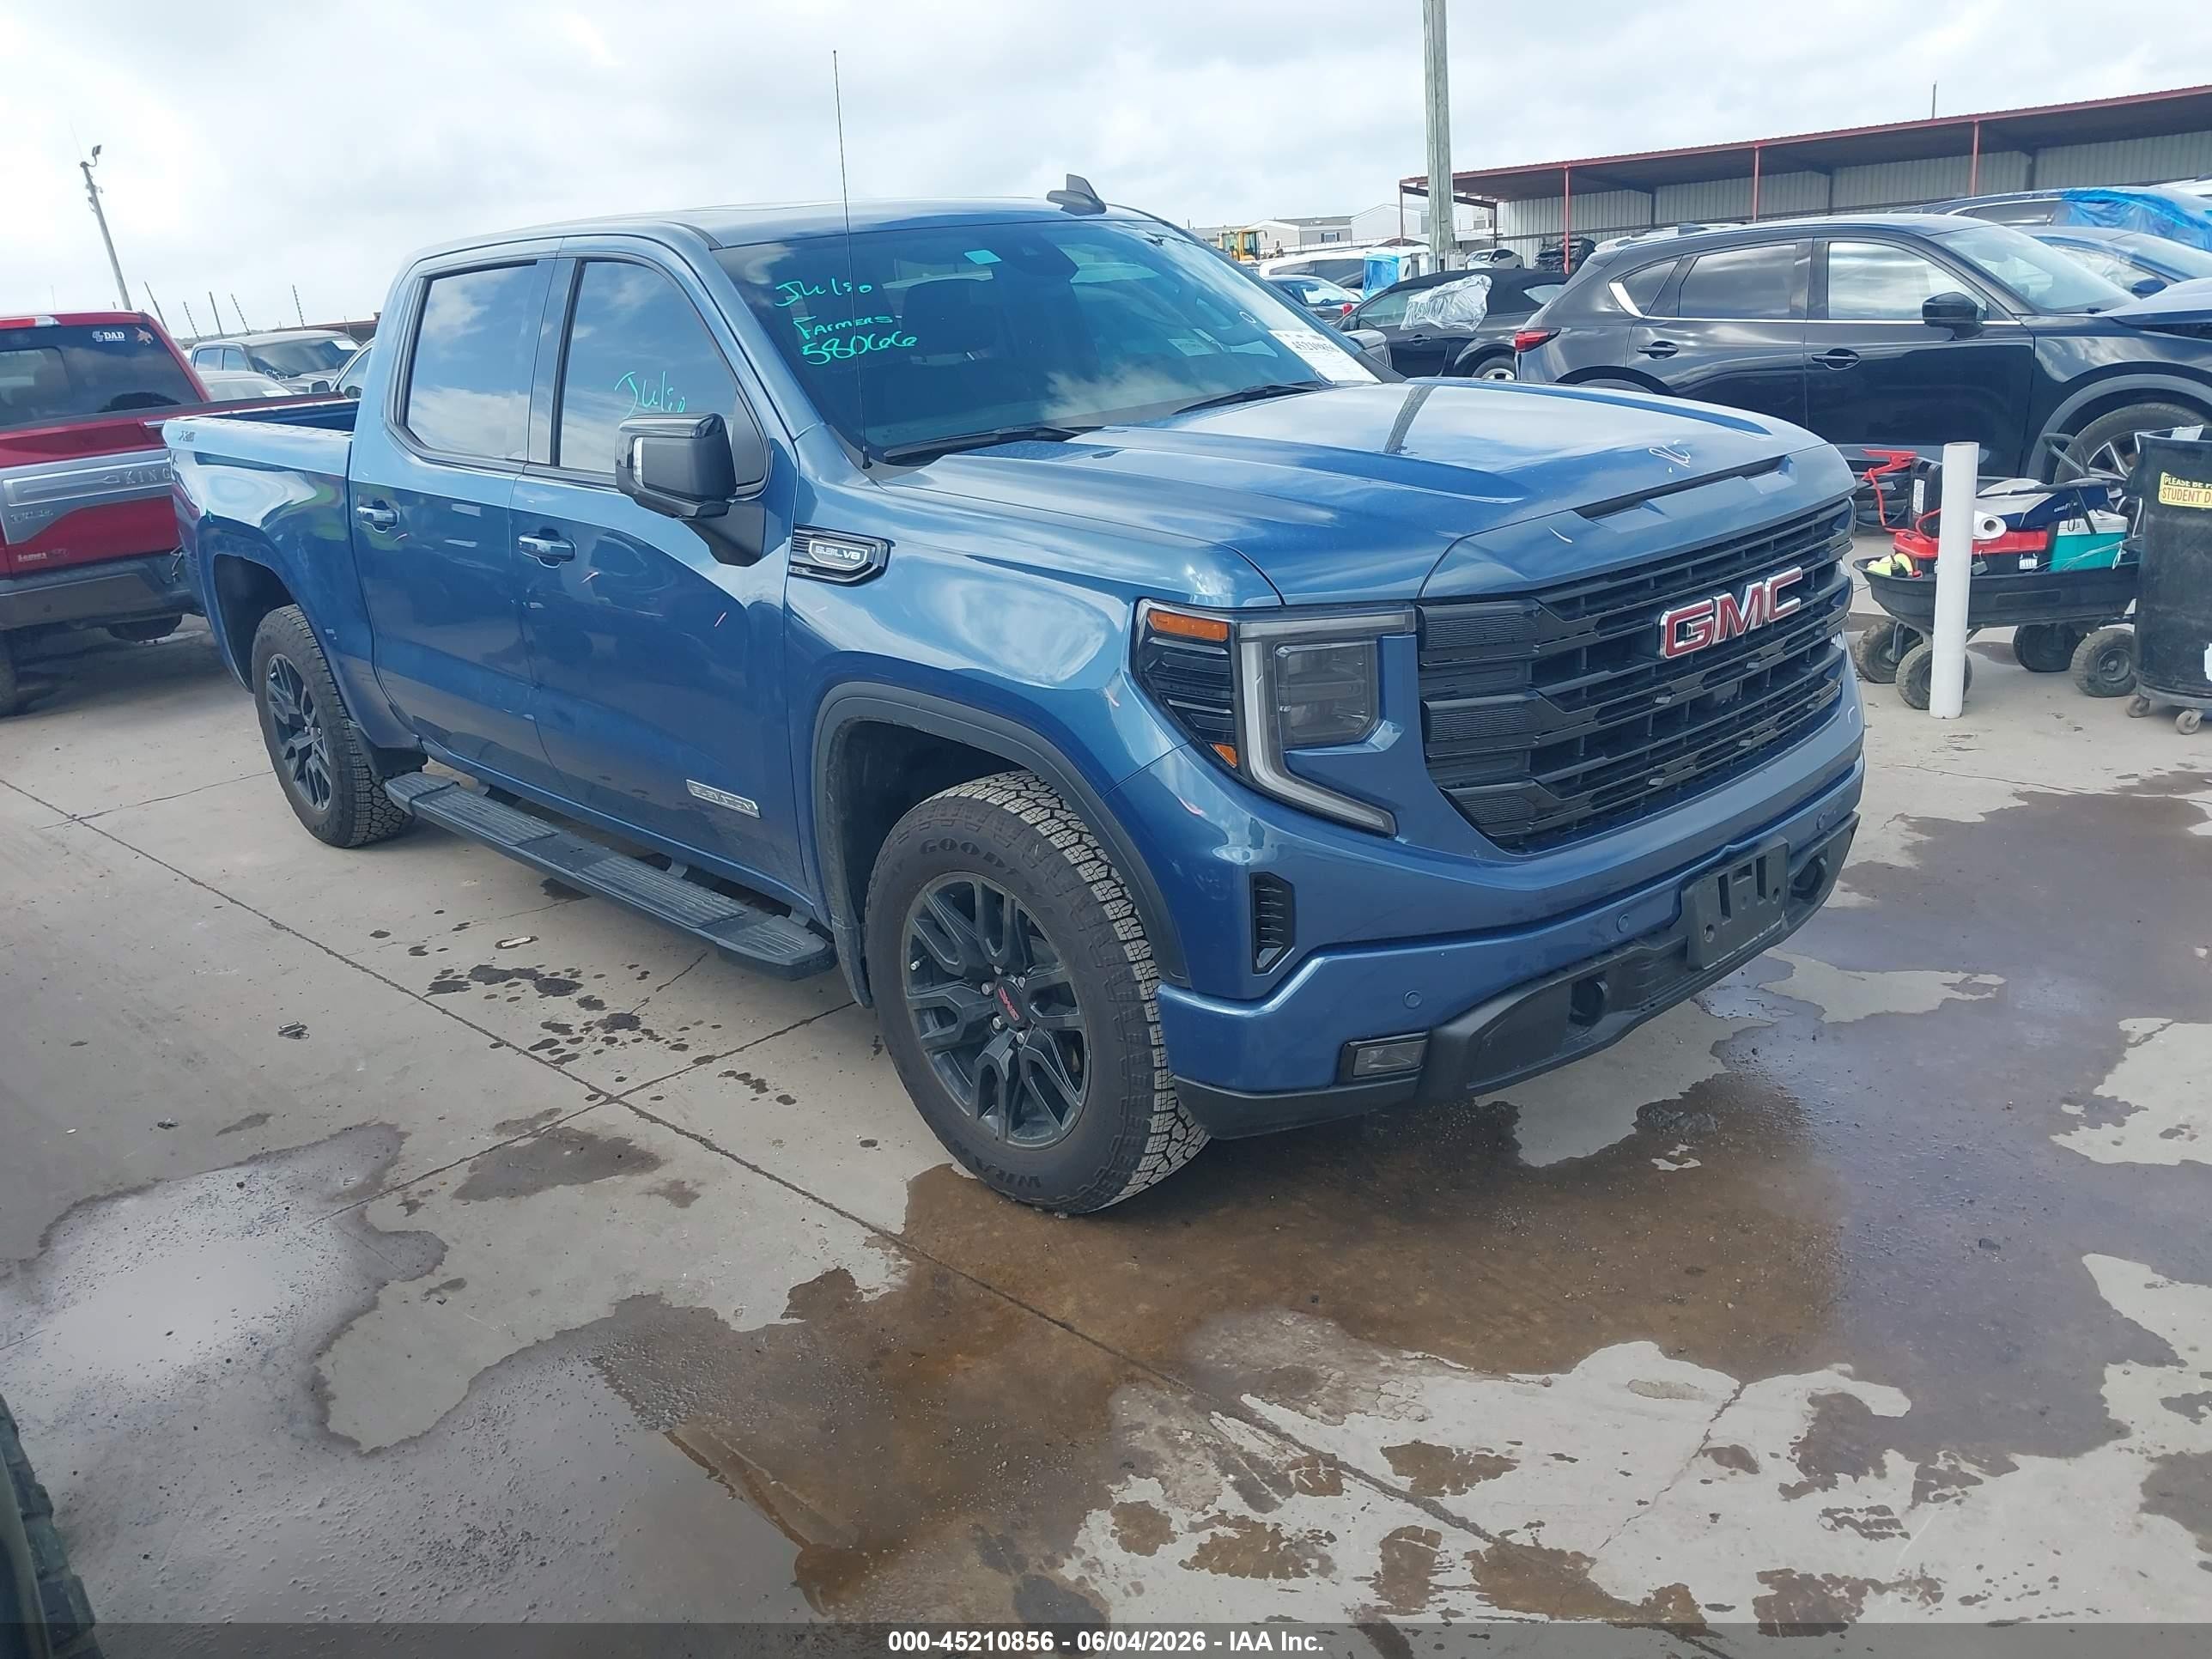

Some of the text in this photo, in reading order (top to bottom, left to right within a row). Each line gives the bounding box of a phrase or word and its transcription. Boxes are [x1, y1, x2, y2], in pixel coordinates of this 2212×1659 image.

[801, 331, 918, 364] 58066
[2164, 477, 2191, 487] PLEASE
[2162, 488, 2202, 501] STUDENT
[1659, 566, 1803, 659] GMC
